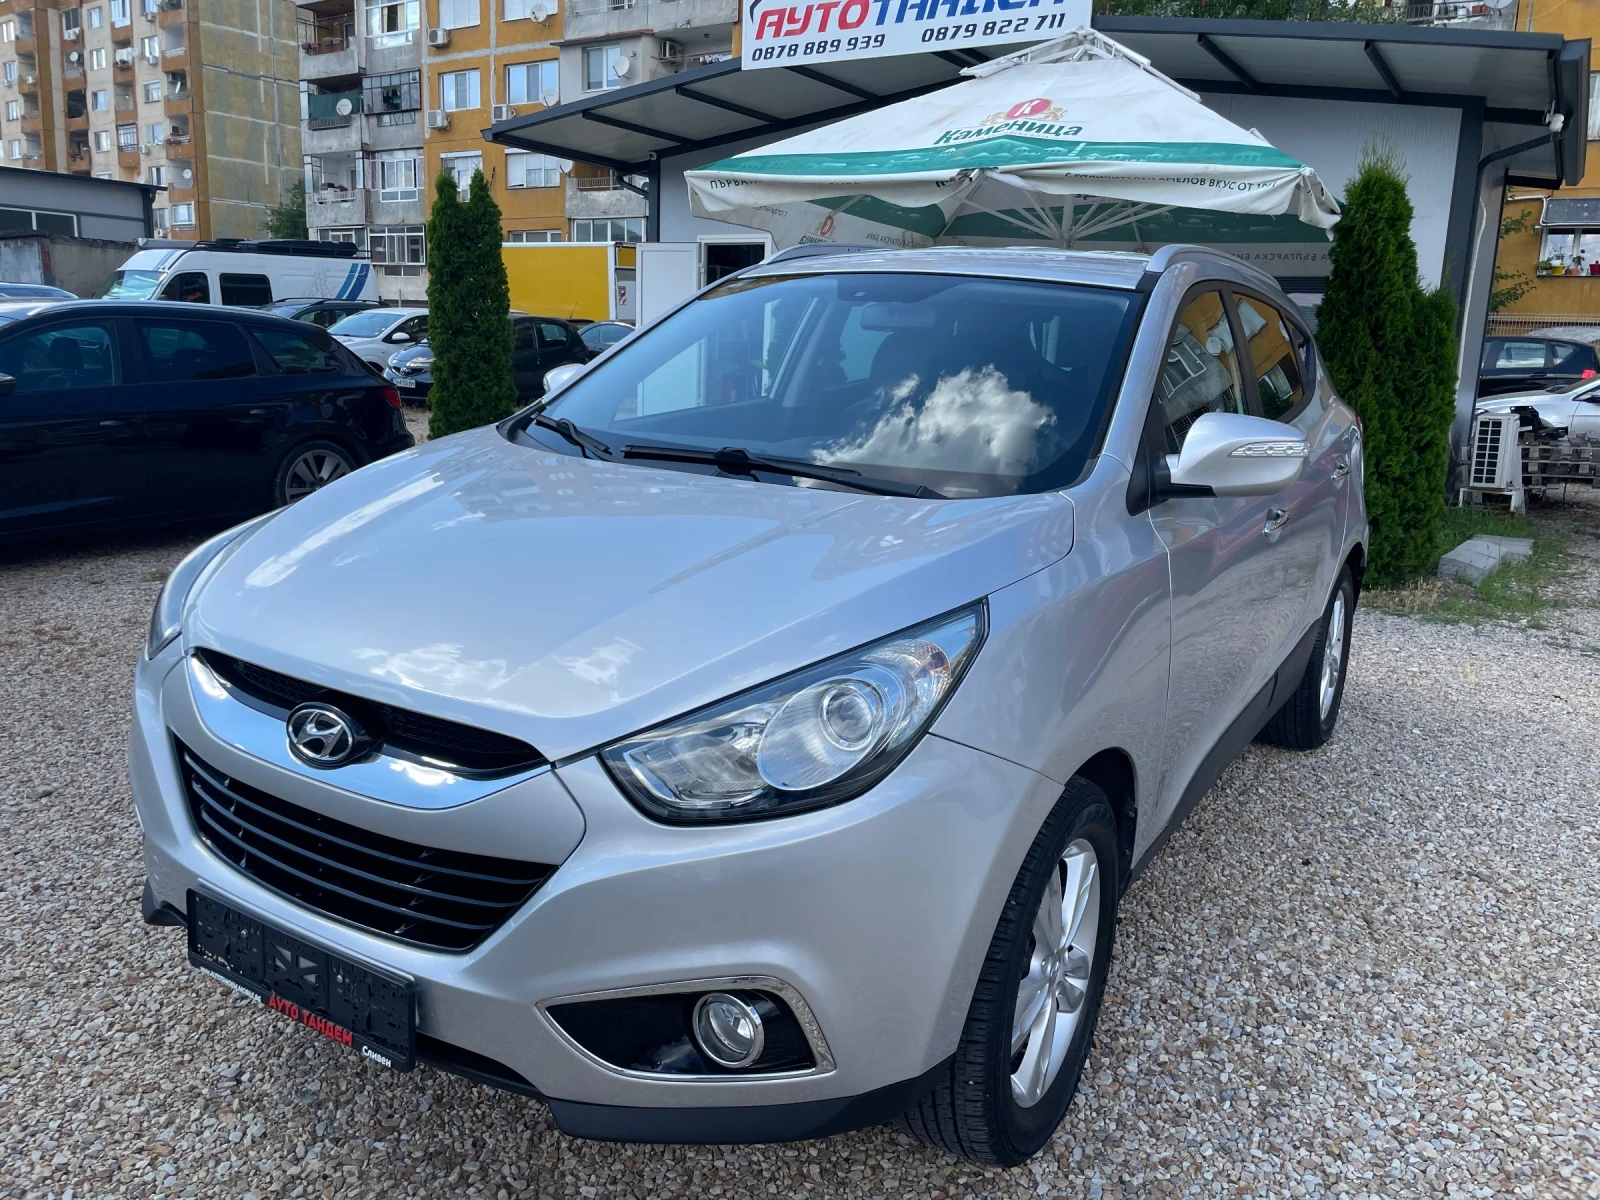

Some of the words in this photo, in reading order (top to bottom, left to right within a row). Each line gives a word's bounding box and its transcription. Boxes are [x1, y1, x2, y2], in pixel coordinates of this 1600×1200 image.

[755, 0, 1064, 40] АУТОТАН
[921, 23, 977, 42] 0879
[982, 17, 1029, 35] 822
[1034, 13, 1065, 30] 711
[752, 44, 799, 61] 0878
[803, 39, 841, 55] 889
[846, 34, 885, 51] 939
[710, 180, 760, 189] ПЪРВА
[1208, 179, 1237, 189] ВКУС
[1237, 183, 1254, 191] ОТ
[268, 994, 299, 1020] АУТО
[301, 1010, 353, 1046] ТАНДЕМ
[362, 1046, 391, 1068] Сливен
